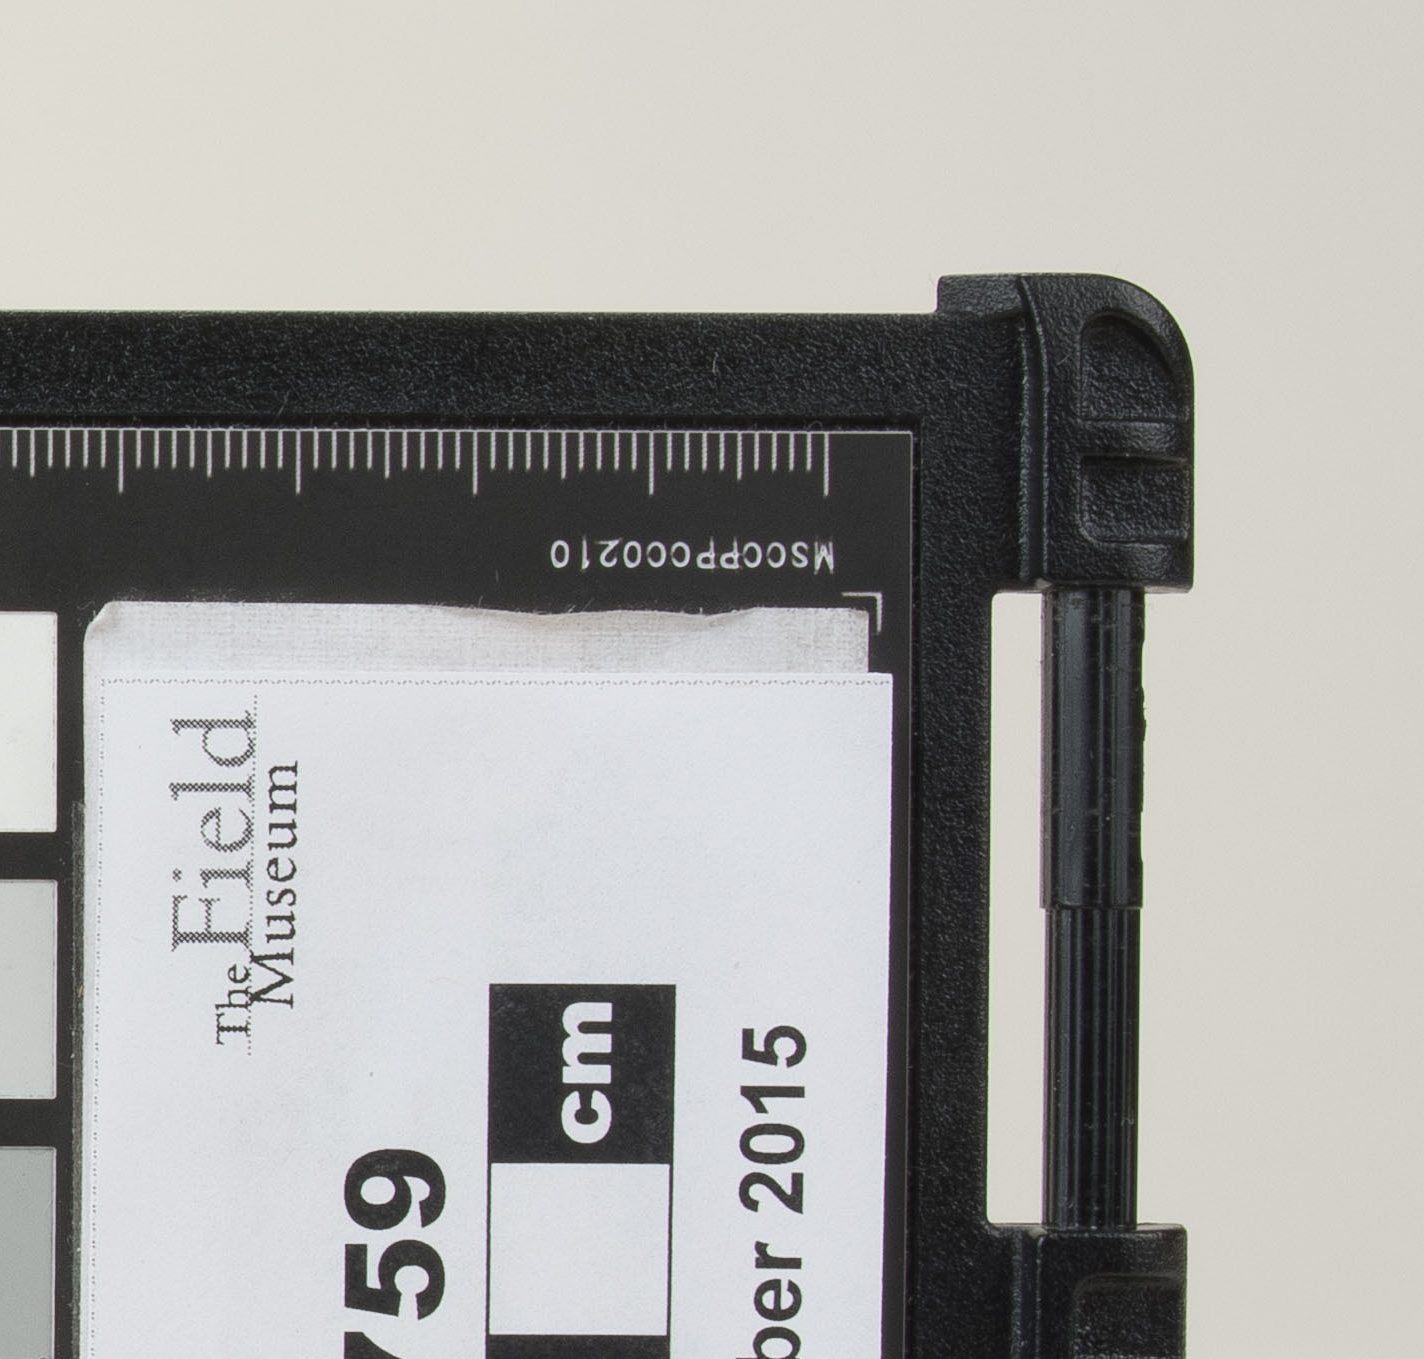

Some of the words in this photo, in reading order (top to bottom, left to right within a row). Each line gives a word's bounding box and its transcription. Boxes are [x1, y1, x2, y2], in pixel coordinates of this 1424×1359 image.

[168, 709, 255, 953] Field
[249, 760, 299, 1009] Museum
[214, 961, 251, 1046] The
[560, 1001, 613, 1144] cm
[738, 1025, 807, 1215] 2015
